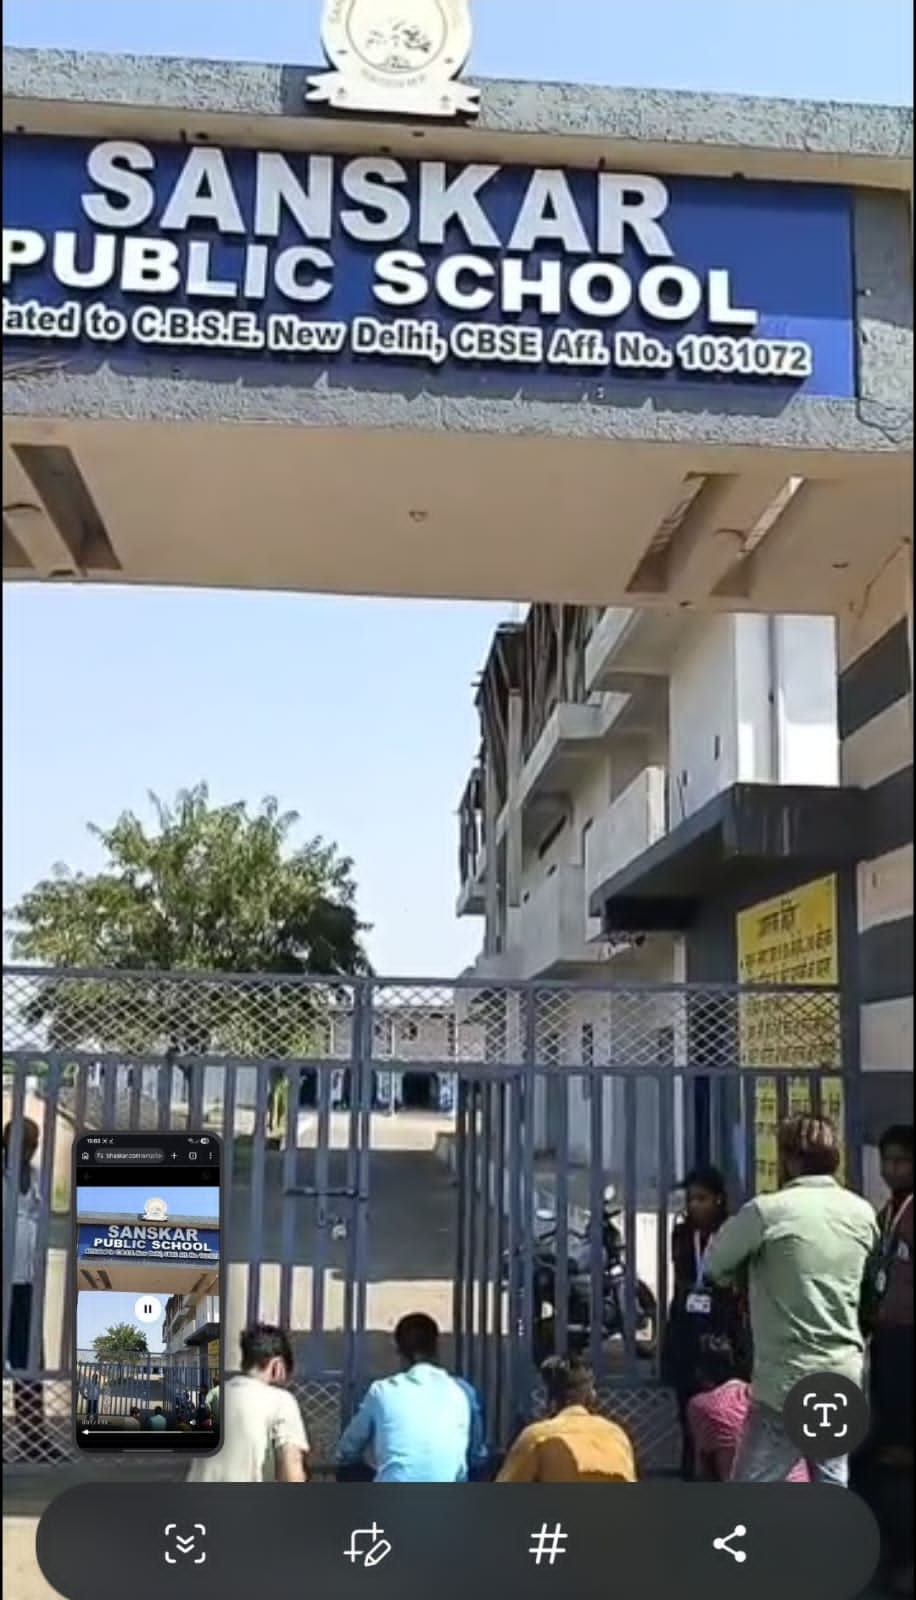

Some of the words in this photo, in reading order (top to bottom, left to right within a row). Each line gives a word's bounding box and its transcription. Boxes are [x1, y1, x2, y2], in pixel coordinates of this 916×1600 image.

[81, 141, 675, 258] SANSKAR
[3, 229, 335, 302] PUBLIC
[372, 250, 759, 326] SCHOOL
[3, 297, 80, 338] ated
[86, 302, 126, 341] to
[132, 304, 264, 346] C.B.S.E.
[269, 316, 346, 354] New
[351, 319, 449, 364] Delhi,
[449, 324, 544, 361] CBSE
[548, 331, 610, 367] Aff.
[614, 334, 671, 371] No.
[677, 335, 813, 379] 1031072
[93, 1238, 146, 1249] PUBLIC
[151, 1240, 212, 1252] SCHOOL
[107, 1225, 199, 1241] SANSKAR
